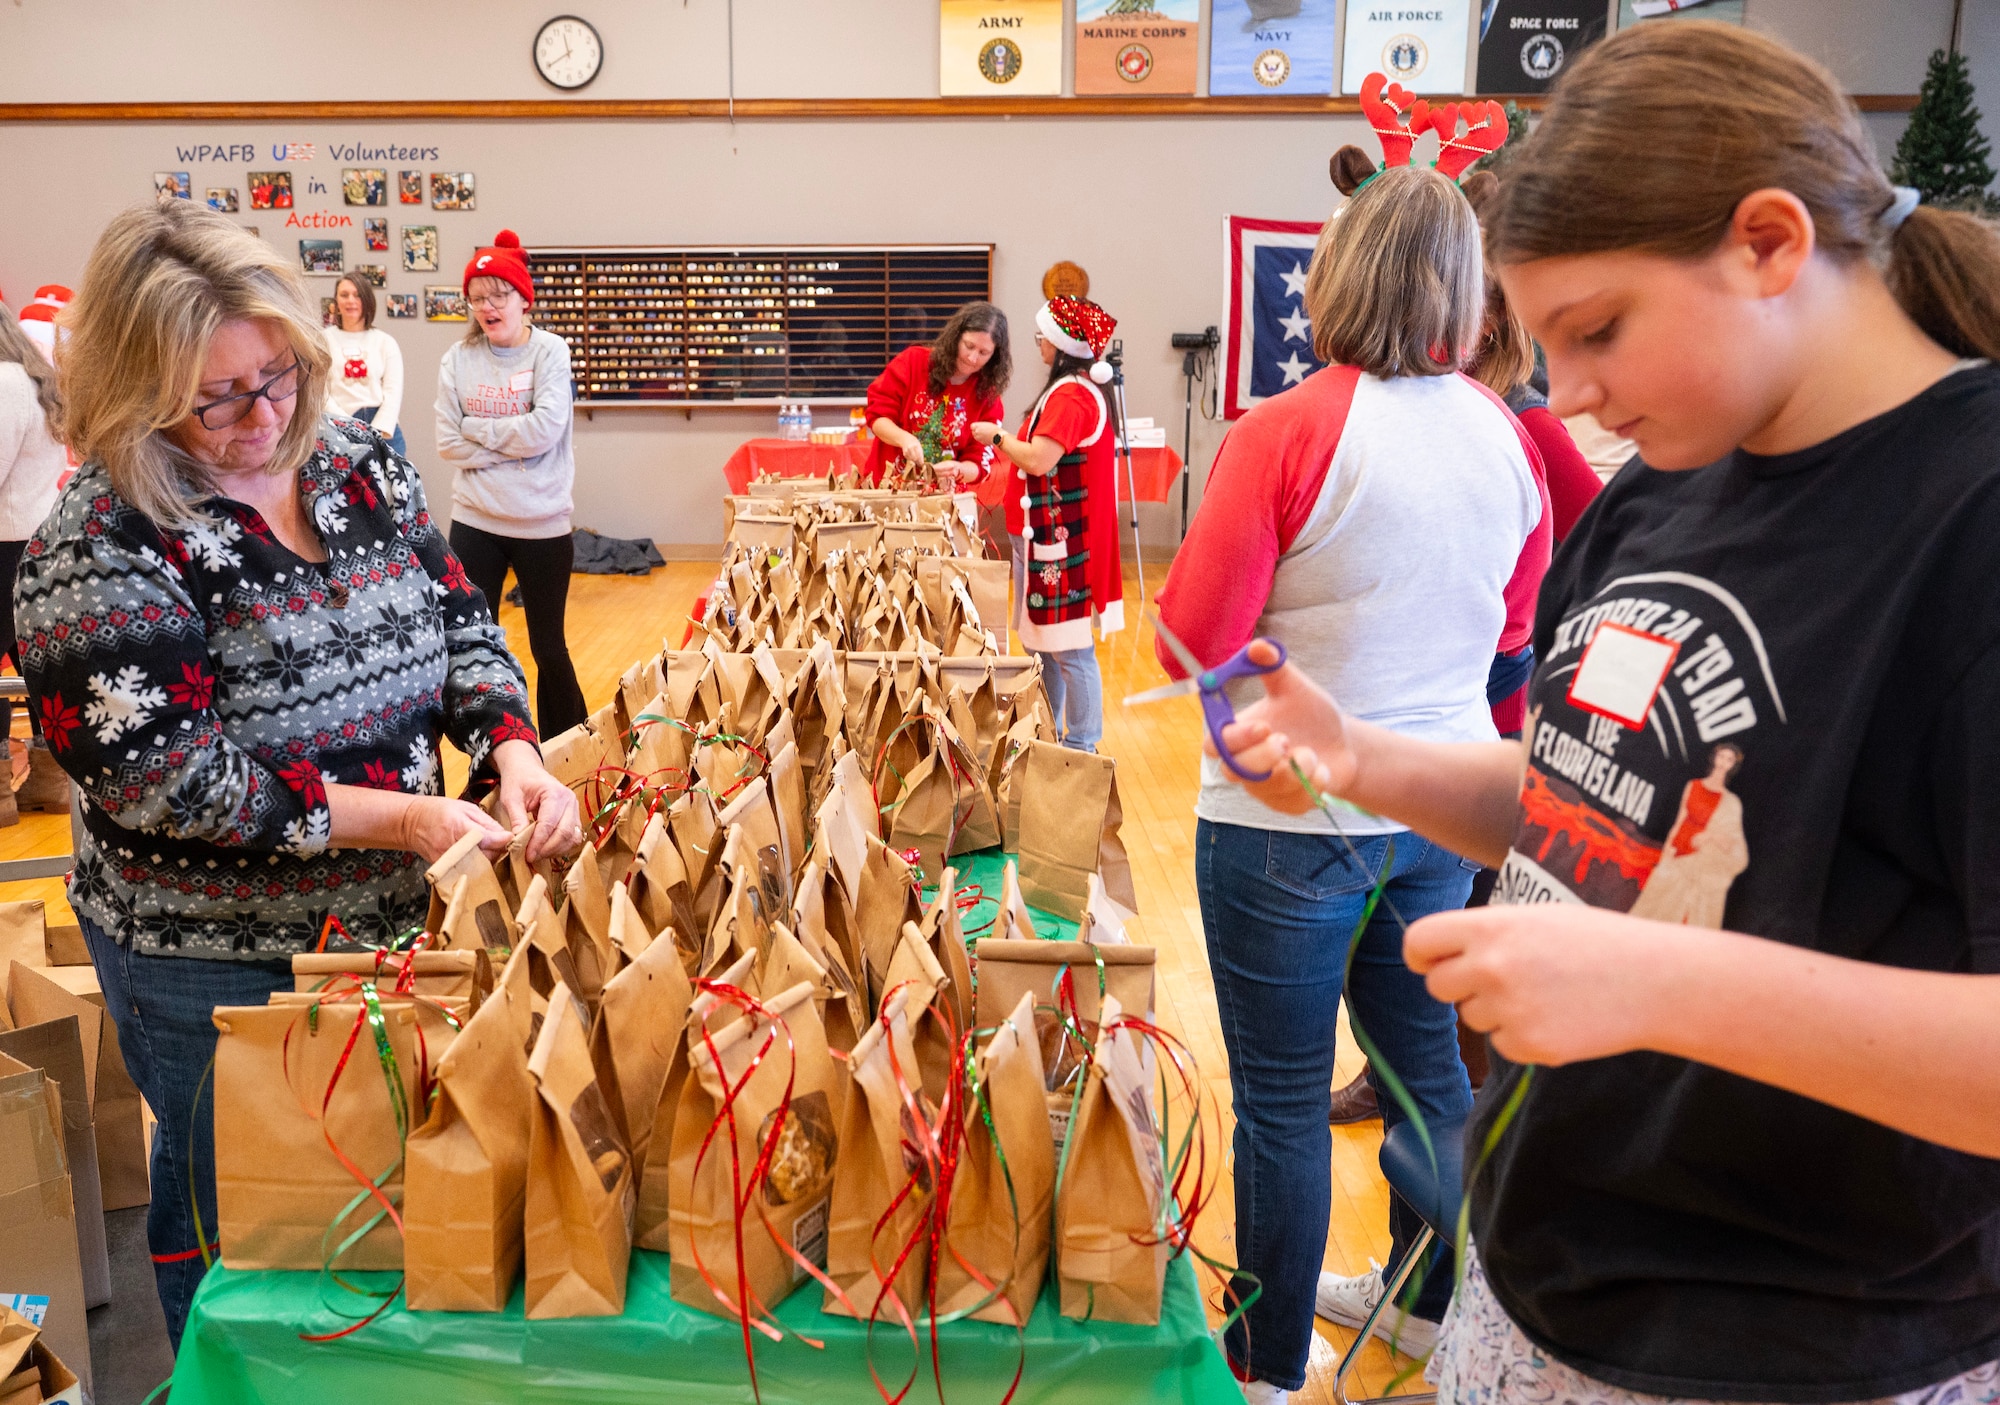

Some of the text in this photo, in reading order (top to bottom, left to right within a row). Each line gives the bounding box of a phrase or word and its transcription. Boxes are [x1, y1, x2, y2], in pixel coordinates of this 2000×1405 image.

[978, 17, 1024, 28] ARMY
[1368, 10, 1444, 21] AIR FORCE
[1509, 16, 1579, 29] SPACE FORCE
[1083, 28, 1188, 38] MARINE CORPS
[1253, 31, 1292, 42] NAVY
[176, 144, 255, 163] WPAFB
[328, 141, 439, 161] Volunteers
[308, 175, 327, 194] in
[285, 210, 353, 229] Action
[478, 384, 519, 400] TEAM
[466, 397, 532, 416] HOLIDAY
[1688, 677, 1758, 743] AD
[1599, 763, 1656, 827] LAVA
